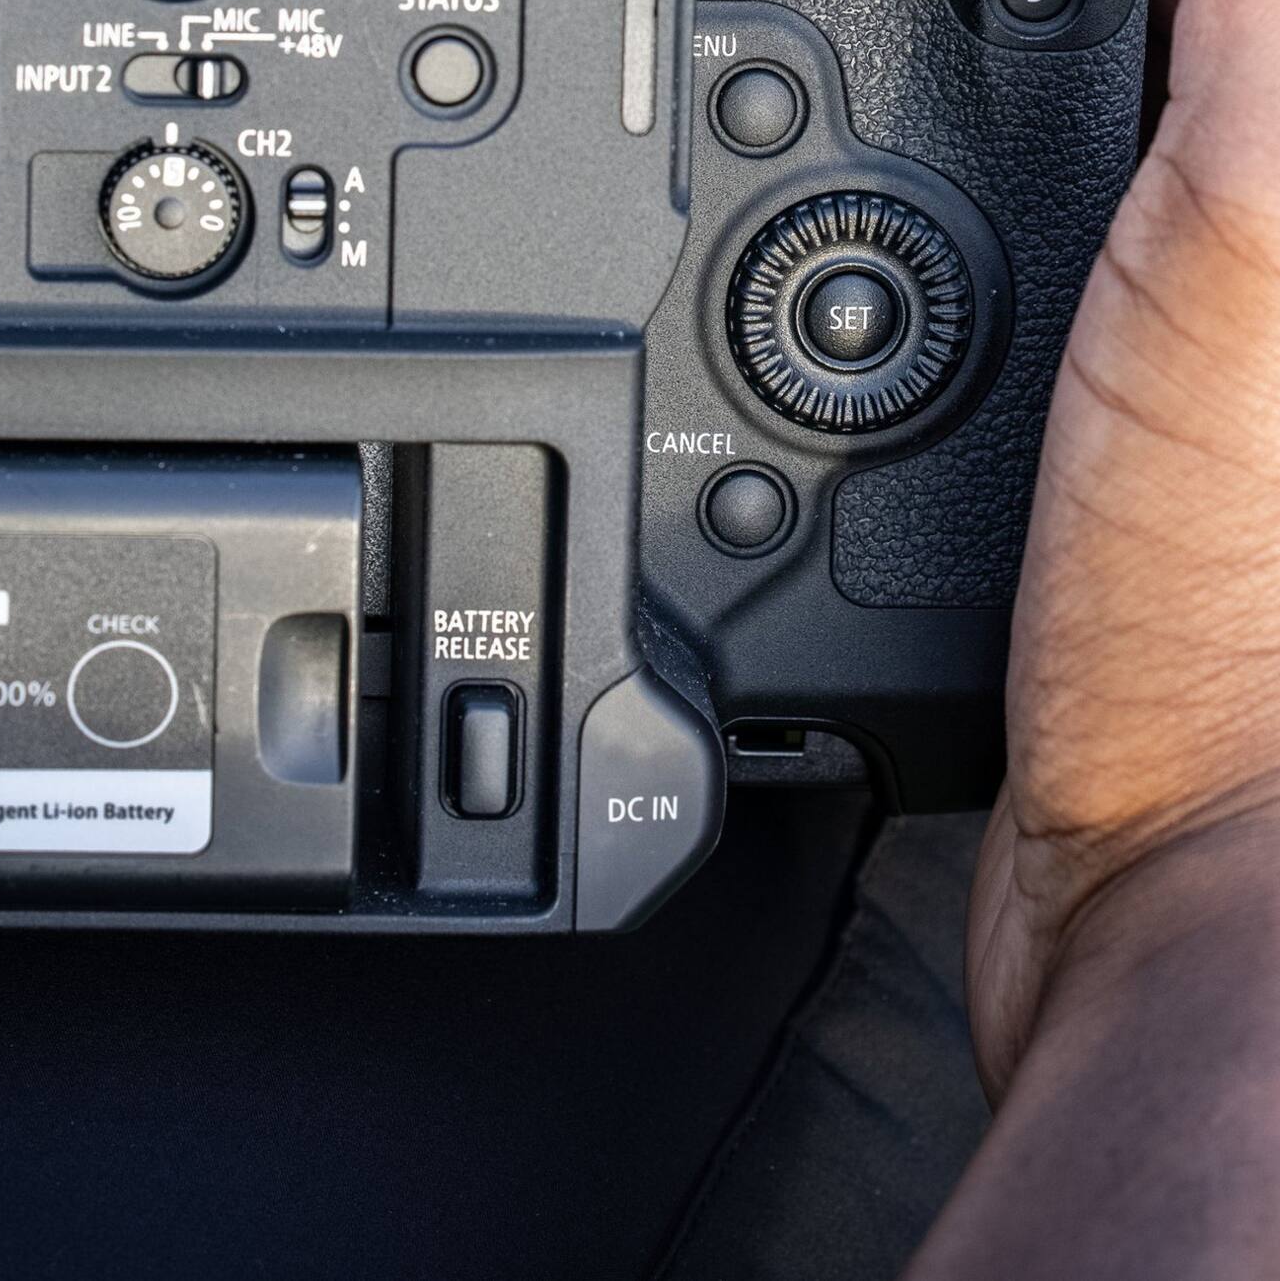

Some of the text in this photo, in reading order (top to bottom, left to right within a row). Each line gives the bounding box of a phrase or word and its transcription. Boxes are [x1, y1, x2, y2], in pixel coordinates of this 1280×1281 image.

[213, 7, 261, 33] MIC
[278, 8, 325, 34] MIC
[83, 22, 135, 48] LINE
[278, 33, 344, 59] +48V
[693, 32, 737, 57] ENU
[237, 128, 292, 157] CH2
[344, 166, 366, 193] A
[116, 205, 142, 232] 10
[199, 214, 225, 232] 0
[341, 239, 367, 267] M
[829, 305, 873, 331] SET
[646, 431, 736, 455] CANCEL
[87, 614, 159, 635] CHECK
[434, 609, 535, 634] BATTERY
[434, 636, 531, 661] RELEASE
[41, 801, 99, 821] Li-ion
[103, 801, 176, 824] Battery
[608, 795, 678, 823] DC IN
